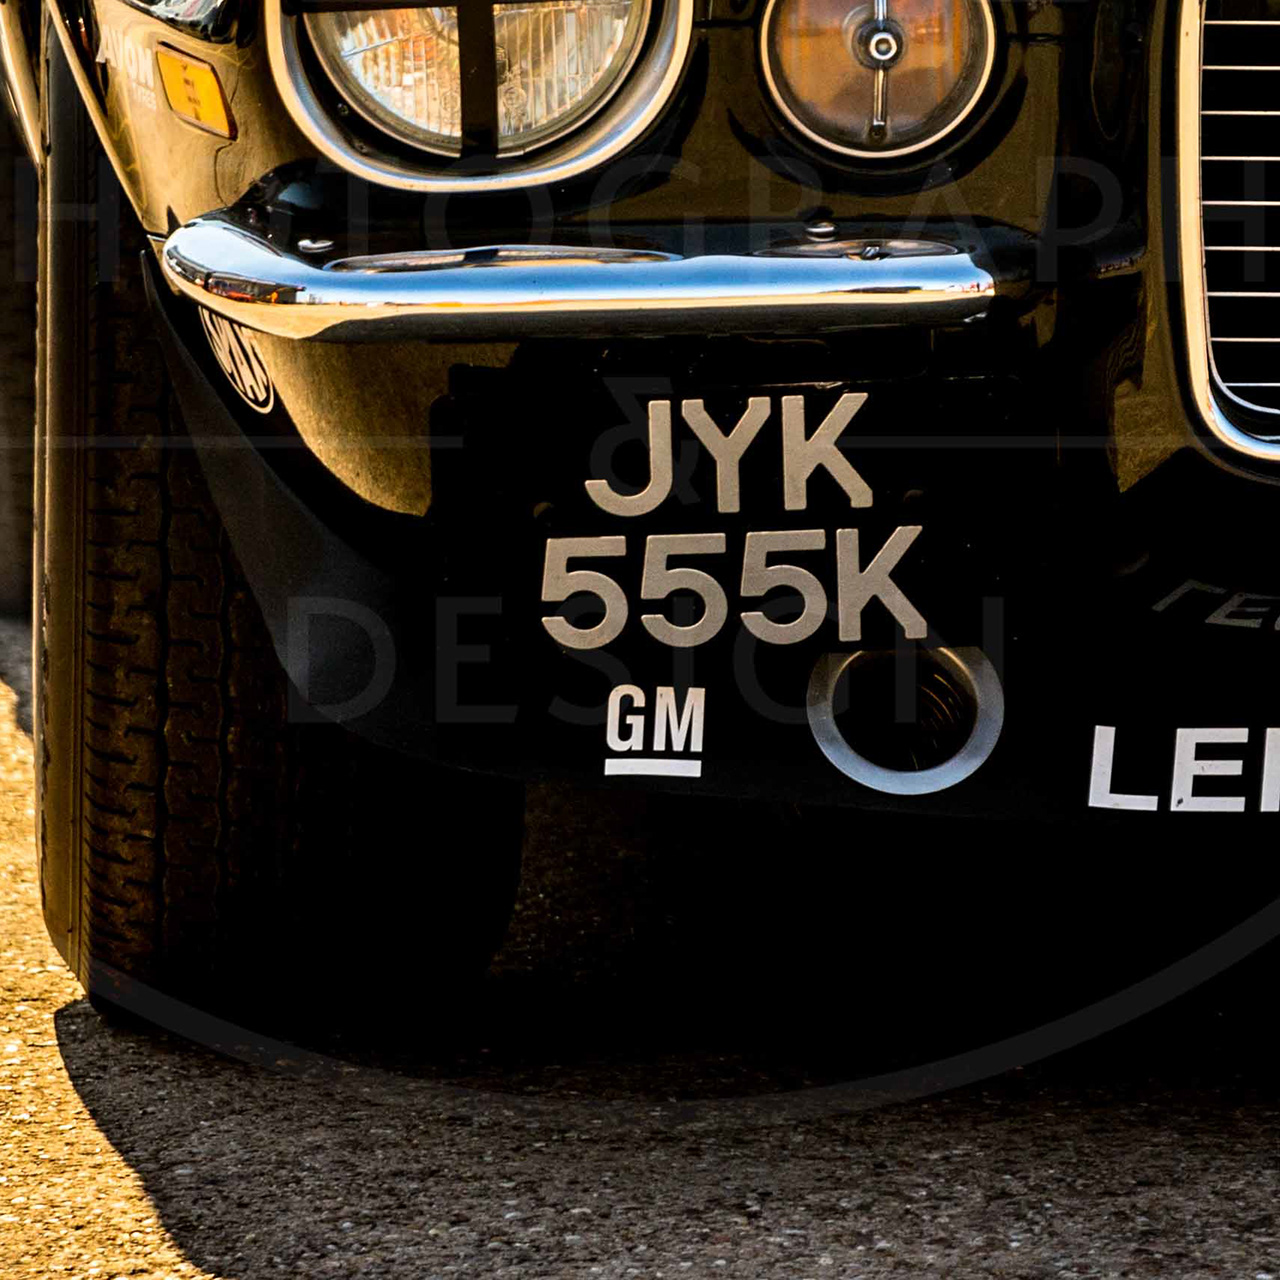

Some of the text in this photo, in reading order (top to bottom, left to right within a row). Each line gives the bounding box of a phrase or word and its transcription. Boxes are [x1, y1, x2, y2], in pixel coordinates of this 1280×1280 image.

[584, 392, 873, 517] JYK
[541, 525, 928, 650] 555K
[606, 684, 706, 753] GM
